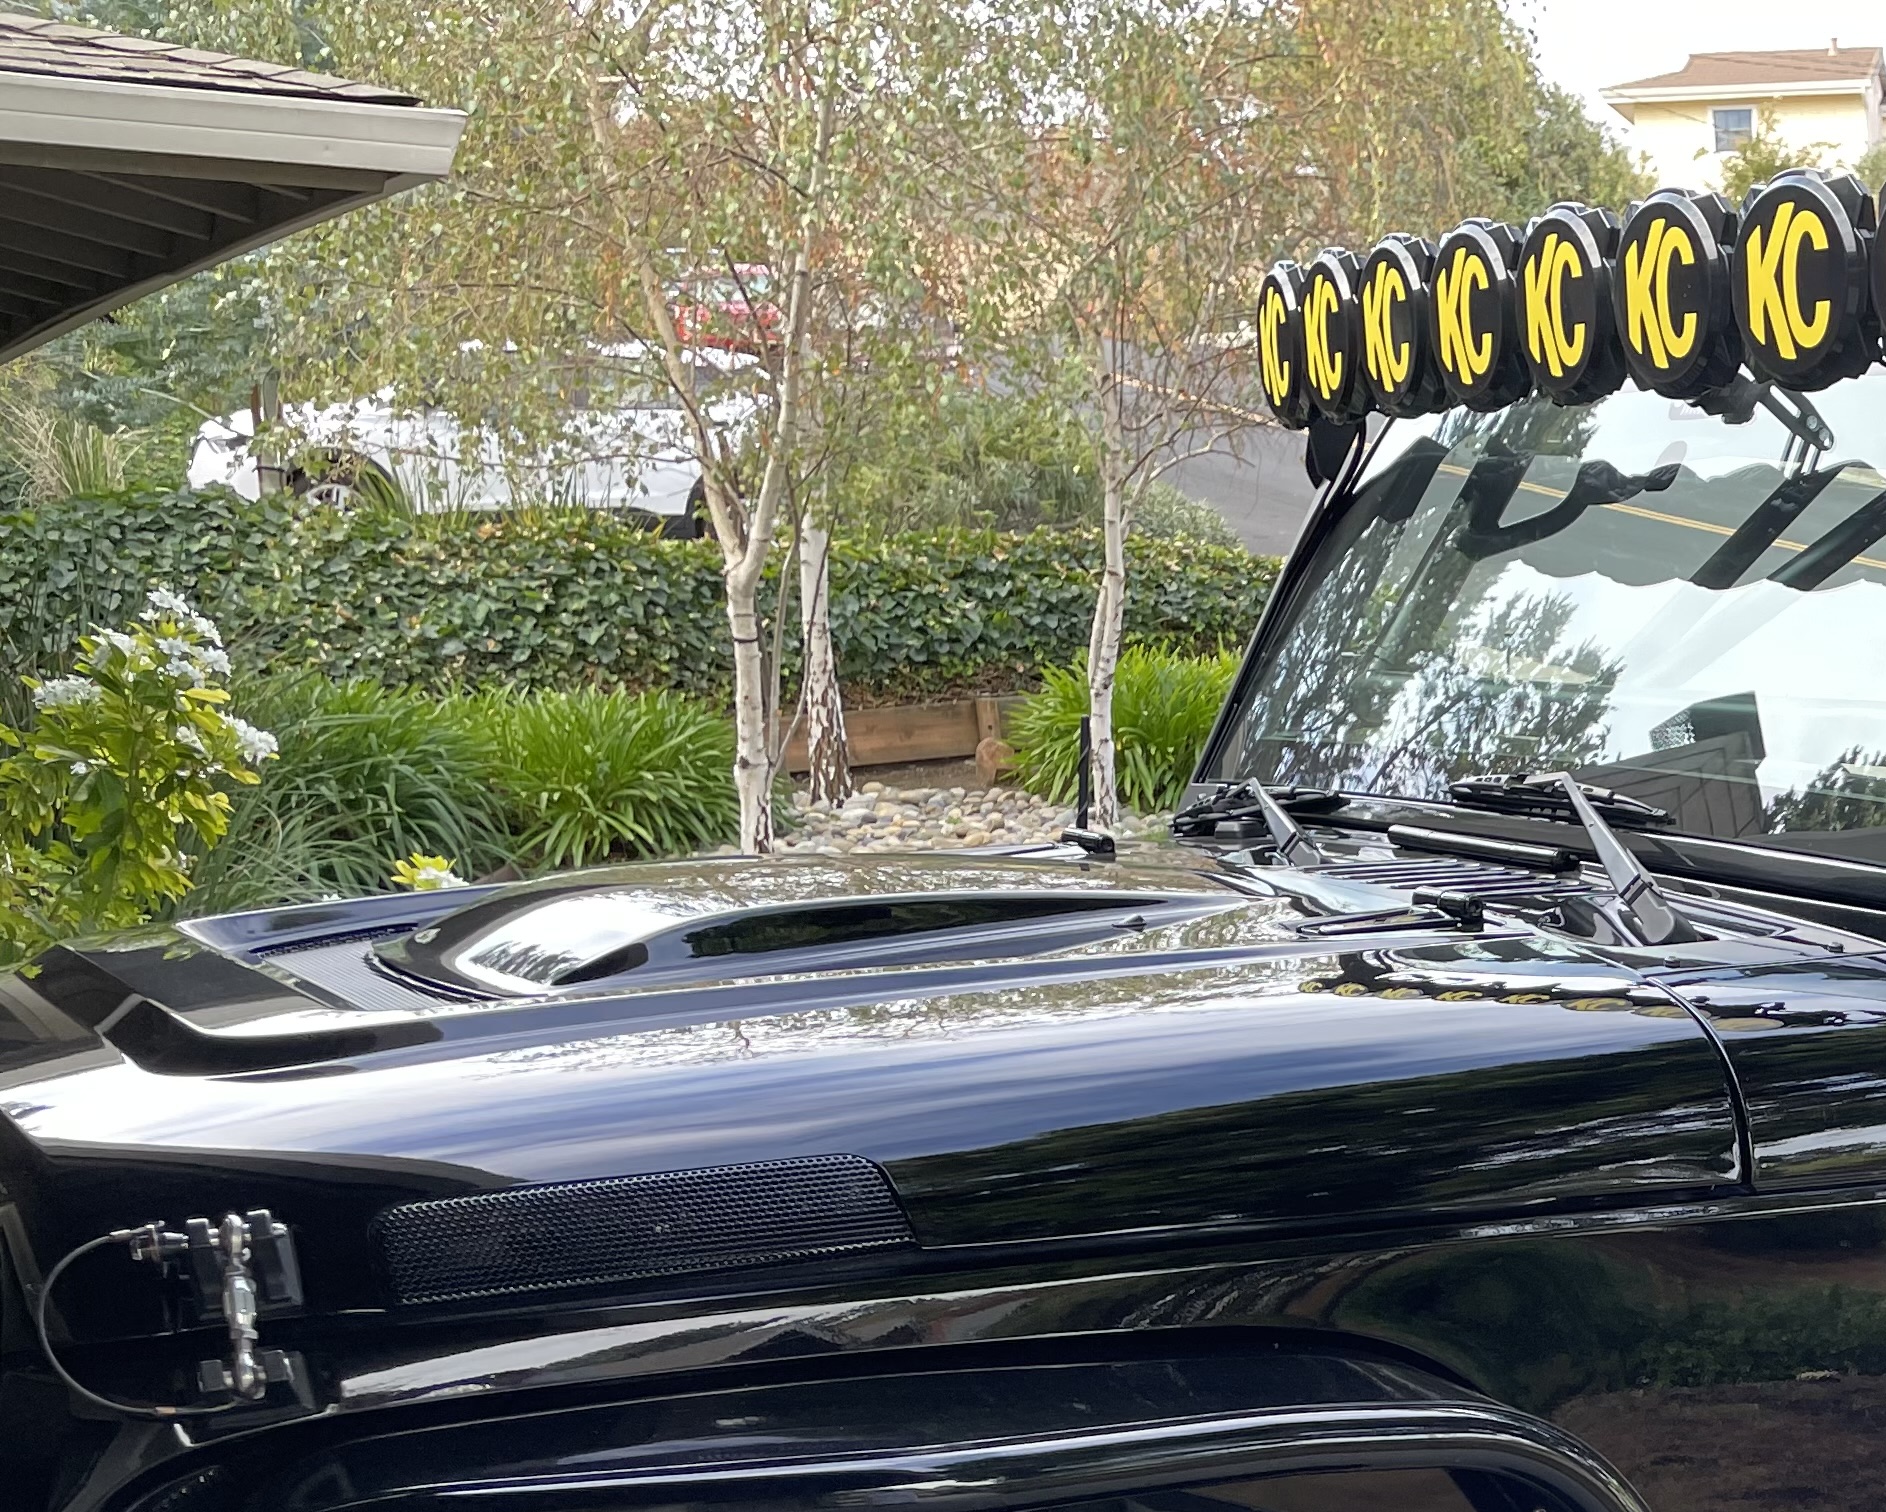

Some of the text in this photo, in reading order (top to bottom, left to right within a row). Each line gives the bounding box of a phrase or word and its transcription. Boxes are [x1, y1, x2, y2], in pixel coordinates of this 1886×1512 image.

[1259, 286, 1290, 406] KC
[1303, 274, 1342, 400] KC
[1362, 261, 1410, 393] KC
[1437, 247, 1493, 385] KC
[1524, 232, 1586, 378] KC
[1625, 218, 1697, 369] KC
[1747, 201, 1831, 361] KC
